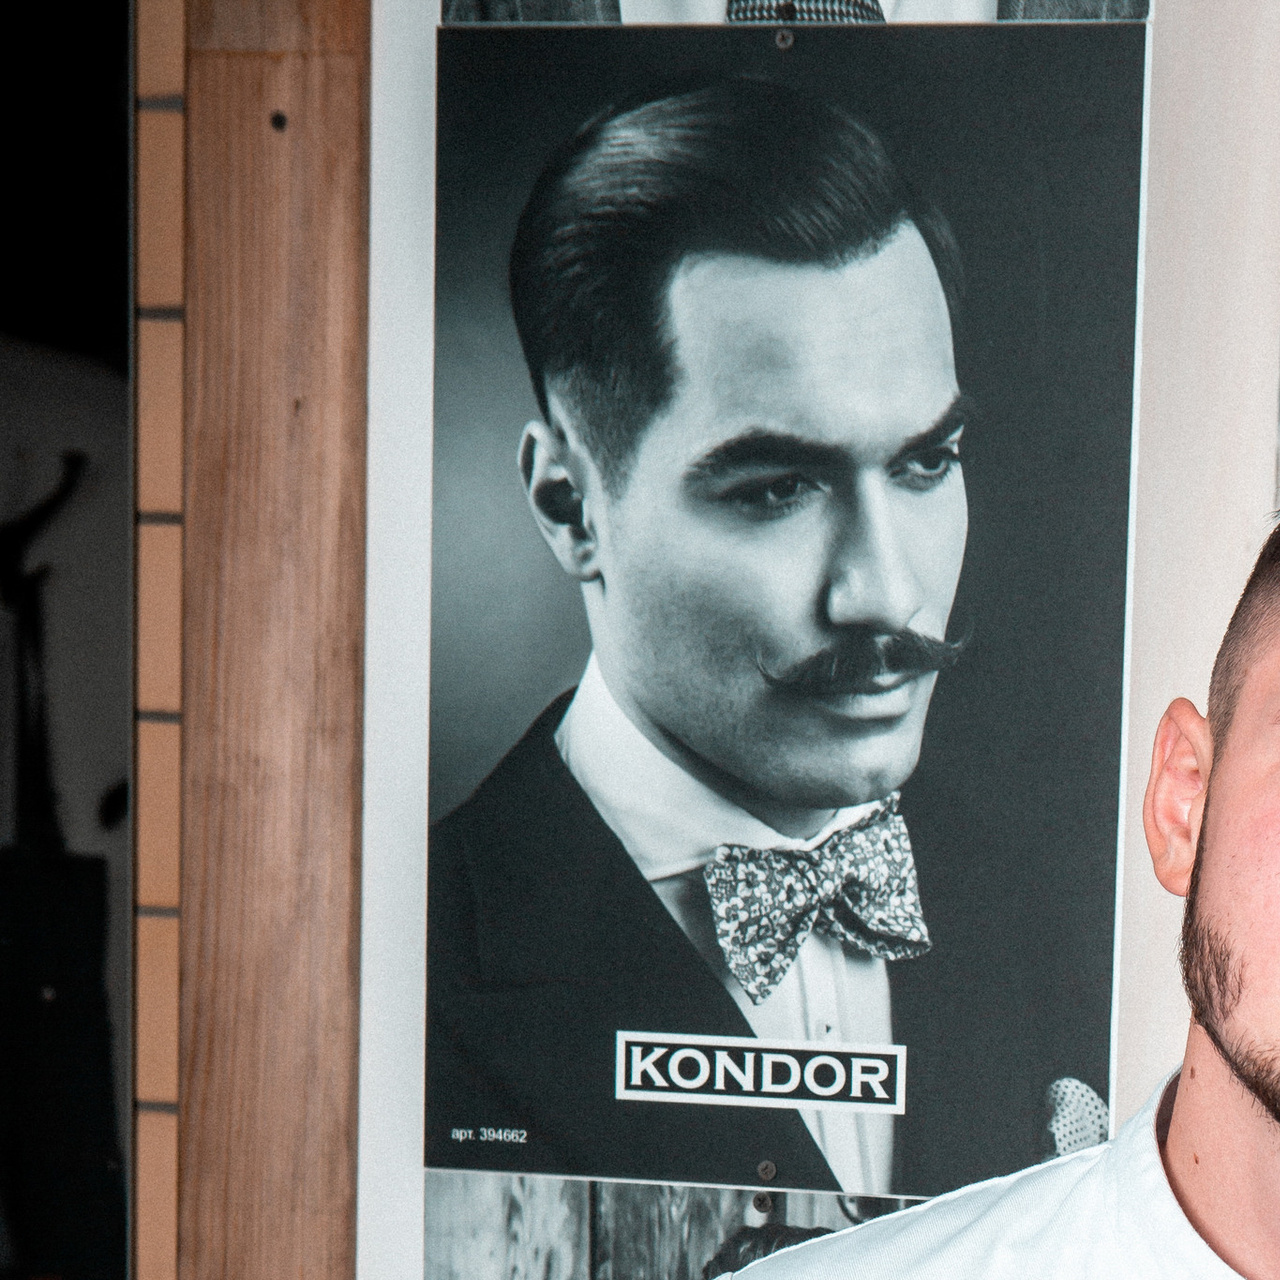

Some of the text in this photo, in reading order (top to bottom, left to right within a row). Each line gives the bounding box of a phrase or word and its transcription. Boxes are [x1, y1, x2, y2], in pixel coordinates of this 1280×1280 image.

[629, 1046, 890, 1100] KONDOR
[451, 1127, 528, 1143] арт. 394662
